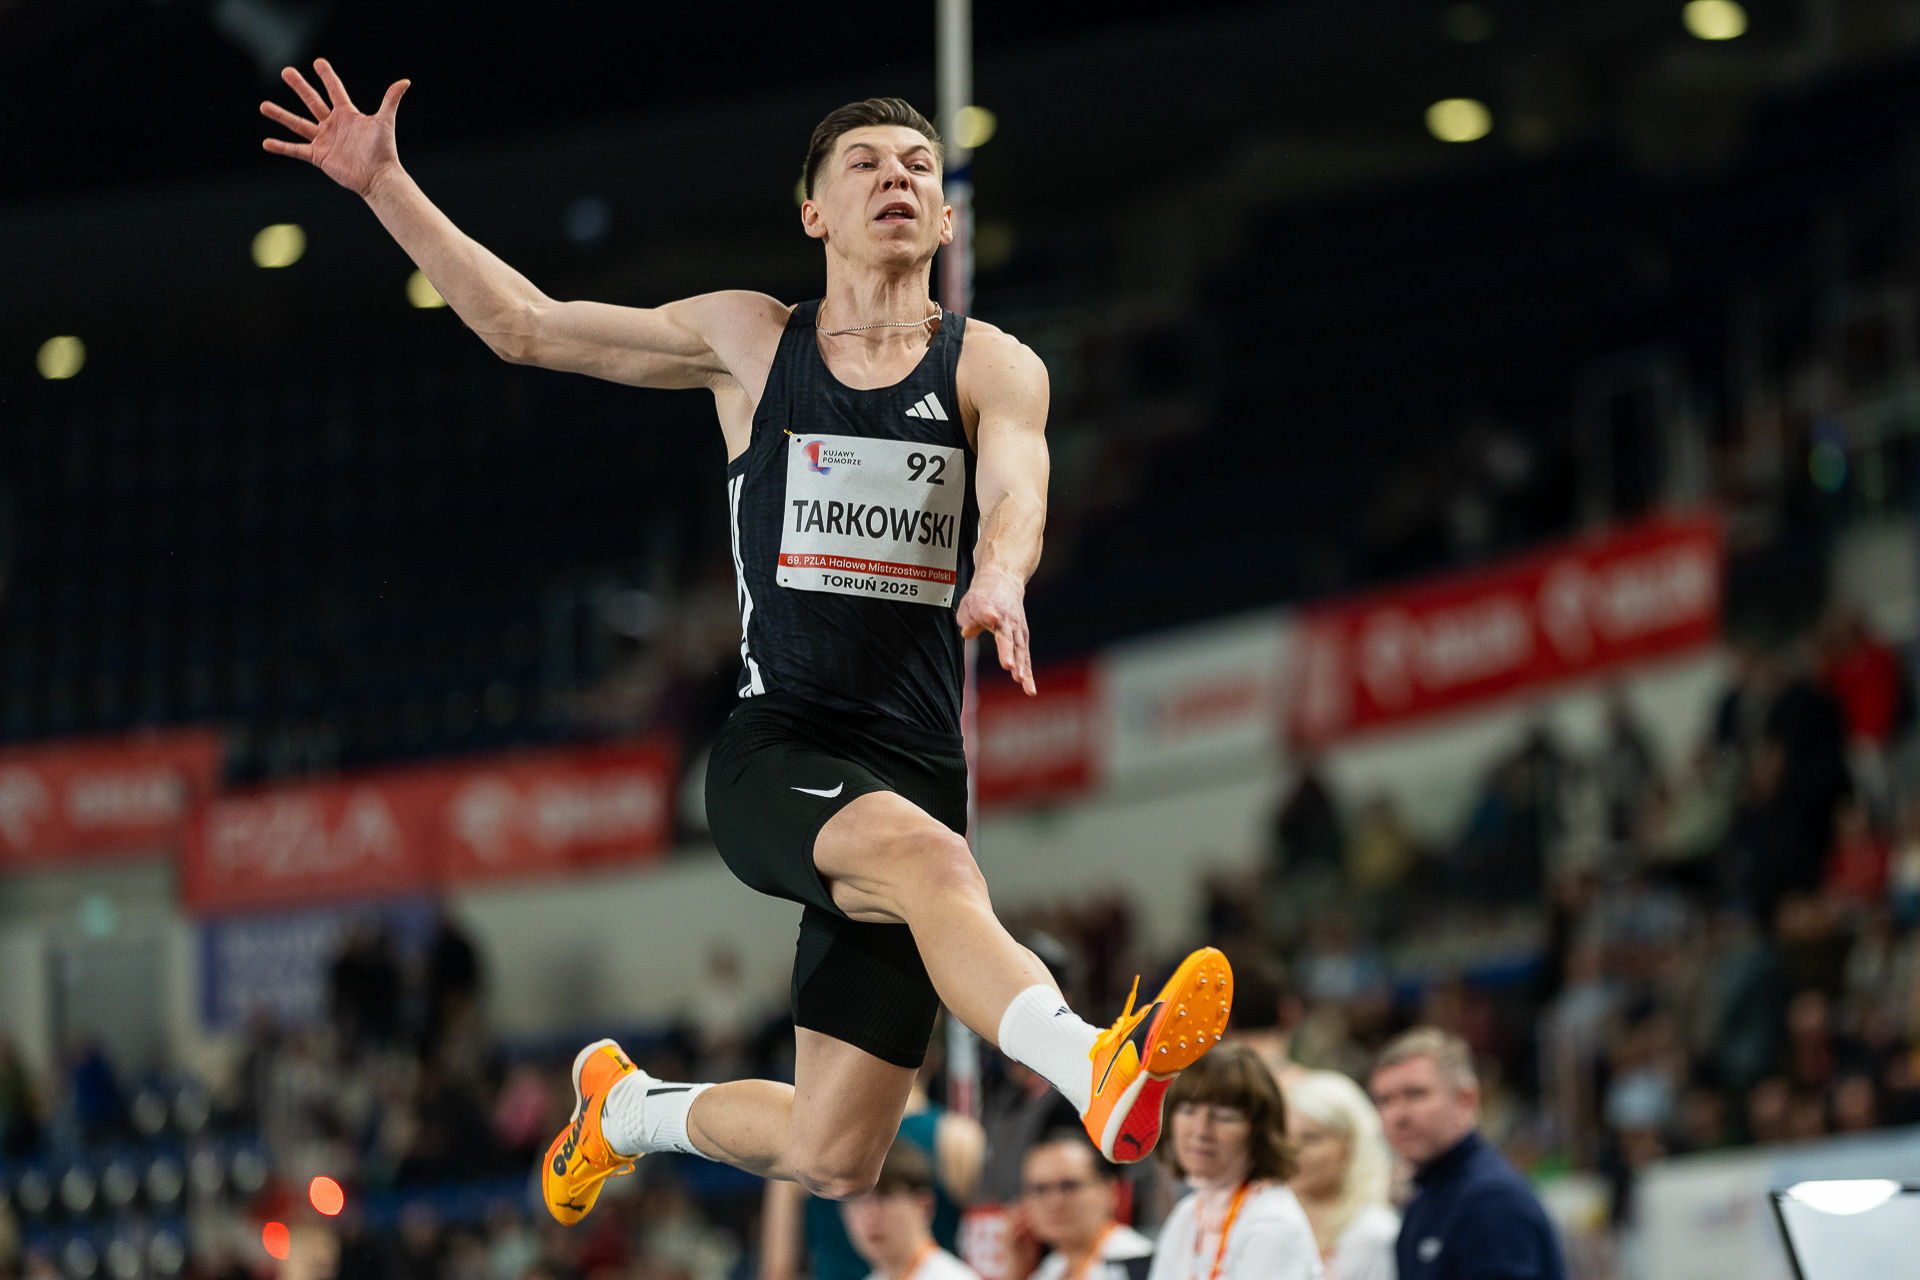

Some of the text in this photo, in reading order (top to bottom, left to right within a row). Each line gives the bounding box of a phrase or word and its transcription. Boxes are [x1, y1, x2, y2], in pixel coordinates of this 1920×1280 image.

[822, 457, 862, 465] POMORZE
[906, 452, 946, 486] 92
[792, 500, 954, 549] TARKOWSKI
[787, 556, 951, 582] 69. PZLA Halowe Mistrzostwa Polski
[821, 574, 919, 597] TORUŃ 2025
